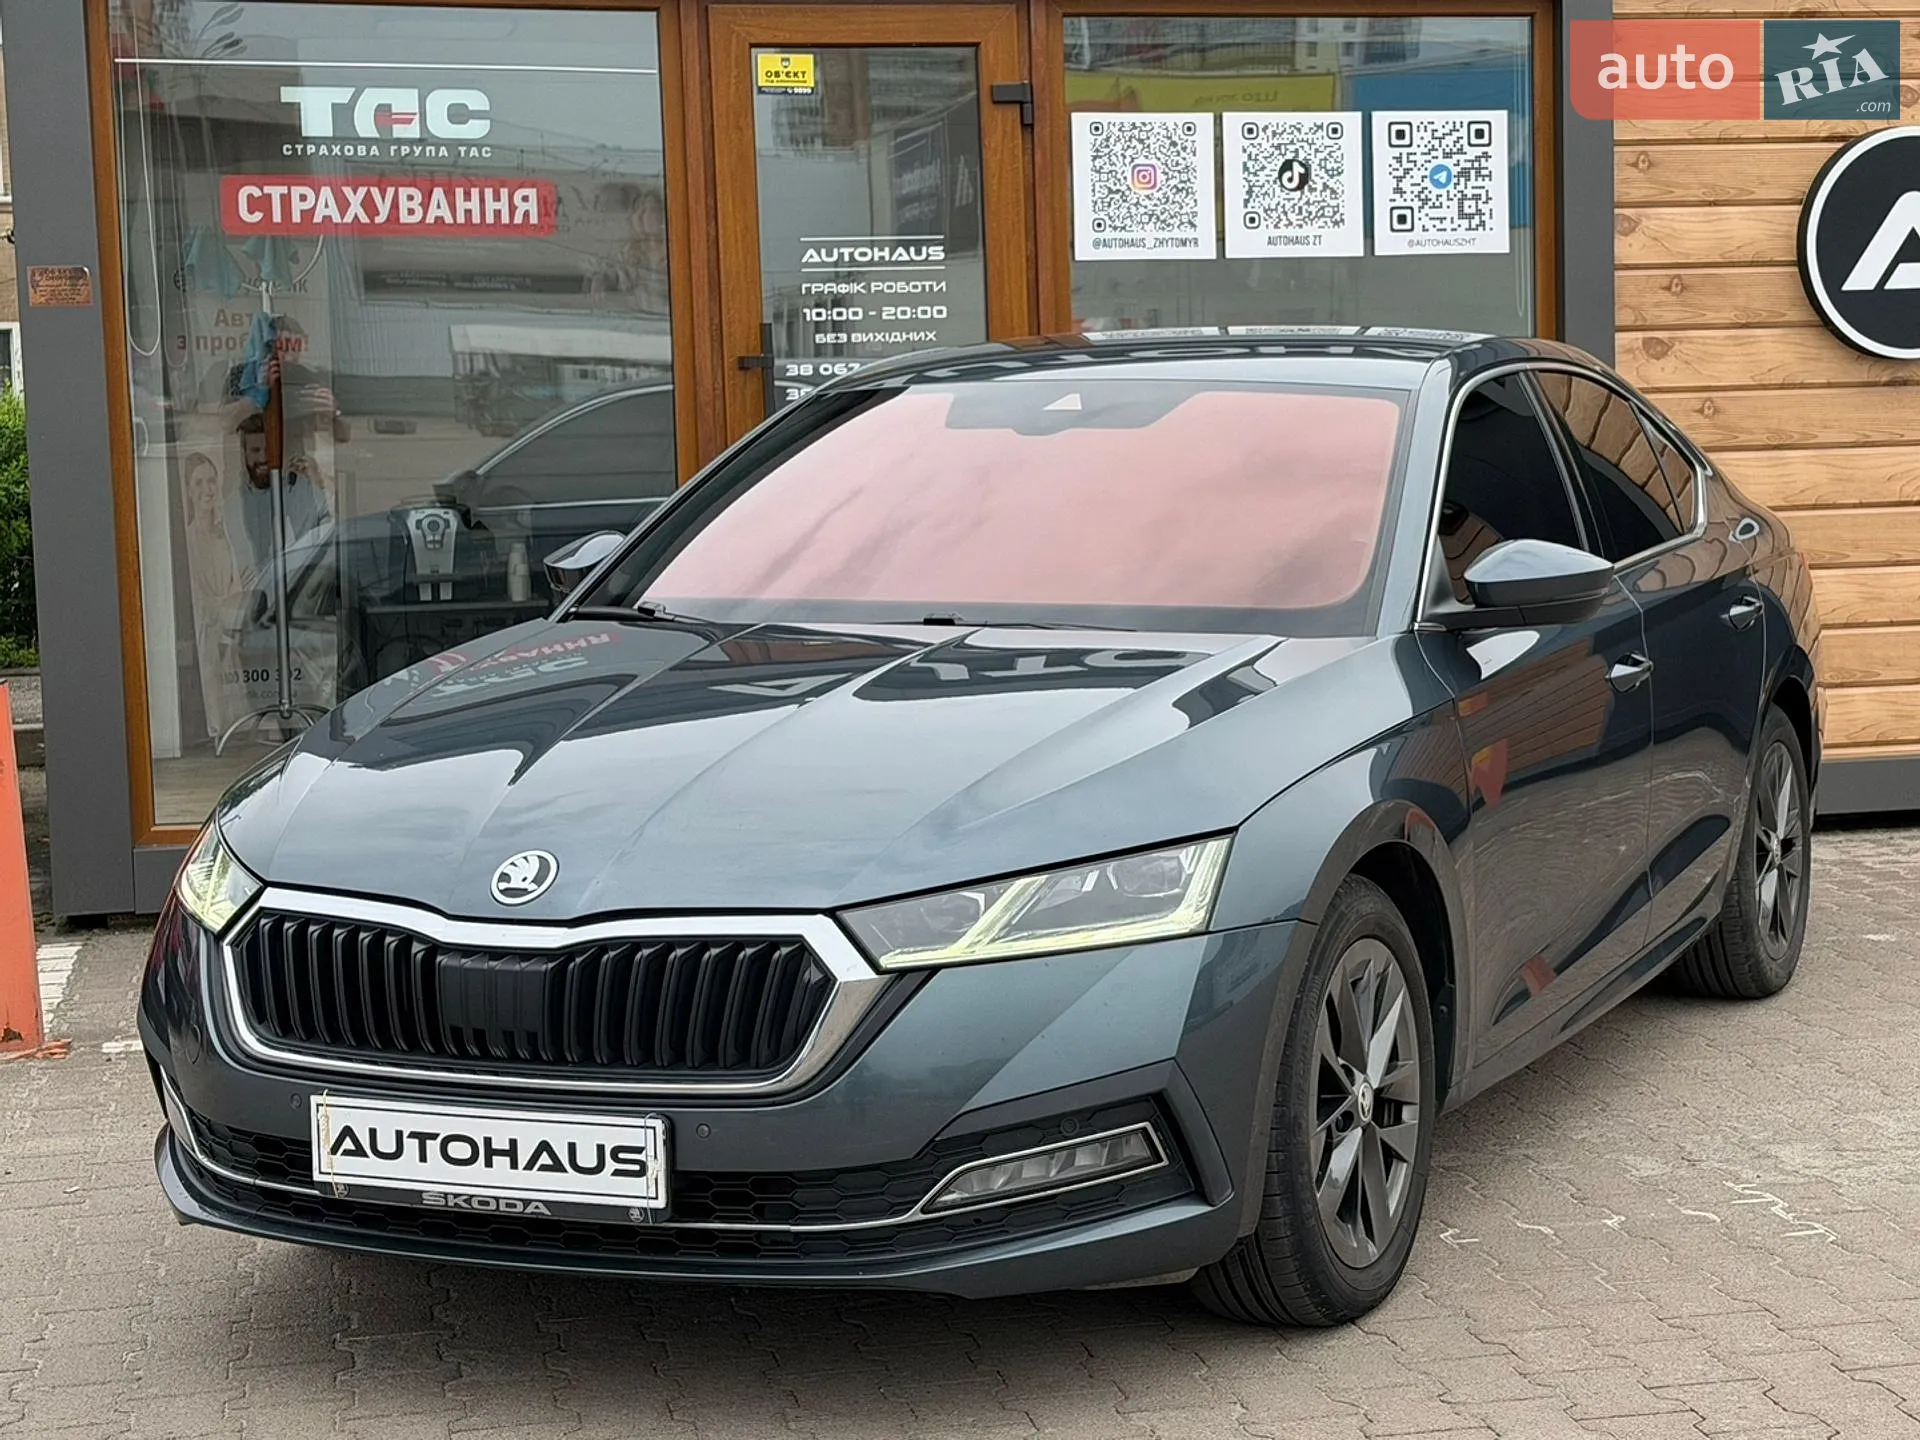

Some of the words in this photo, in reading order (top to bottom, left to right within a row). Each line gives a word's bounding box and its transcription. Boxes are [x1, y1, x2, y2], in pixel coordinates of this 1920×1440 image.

[282, 144, 380, 157] СТРАХОВА
[390, 145, 448, 158] ГРУПА
[458, 146, 492, 158] ТАС
[238, 185, 538, 225] СТРАХУВАННЯ
[1267, 235, 1311, 246] AUTOHAUS
[1313, 235, 1323, 246] ZT
[801, 246, 945, 263] AUTOHAUS
[801, 282, 866, 295] ГРАФІК
[870, 281, 946, 294] РОБОТИ
[803, 307, 863, 321] 10:00
[881, 305, 947, 320] 20:00
[815, 333, 847, 344] БЕЗ
[851, 331, 936, 343] ВИХІДНИХ
[330, 1124, 648, 1179] AUTOHAUS
